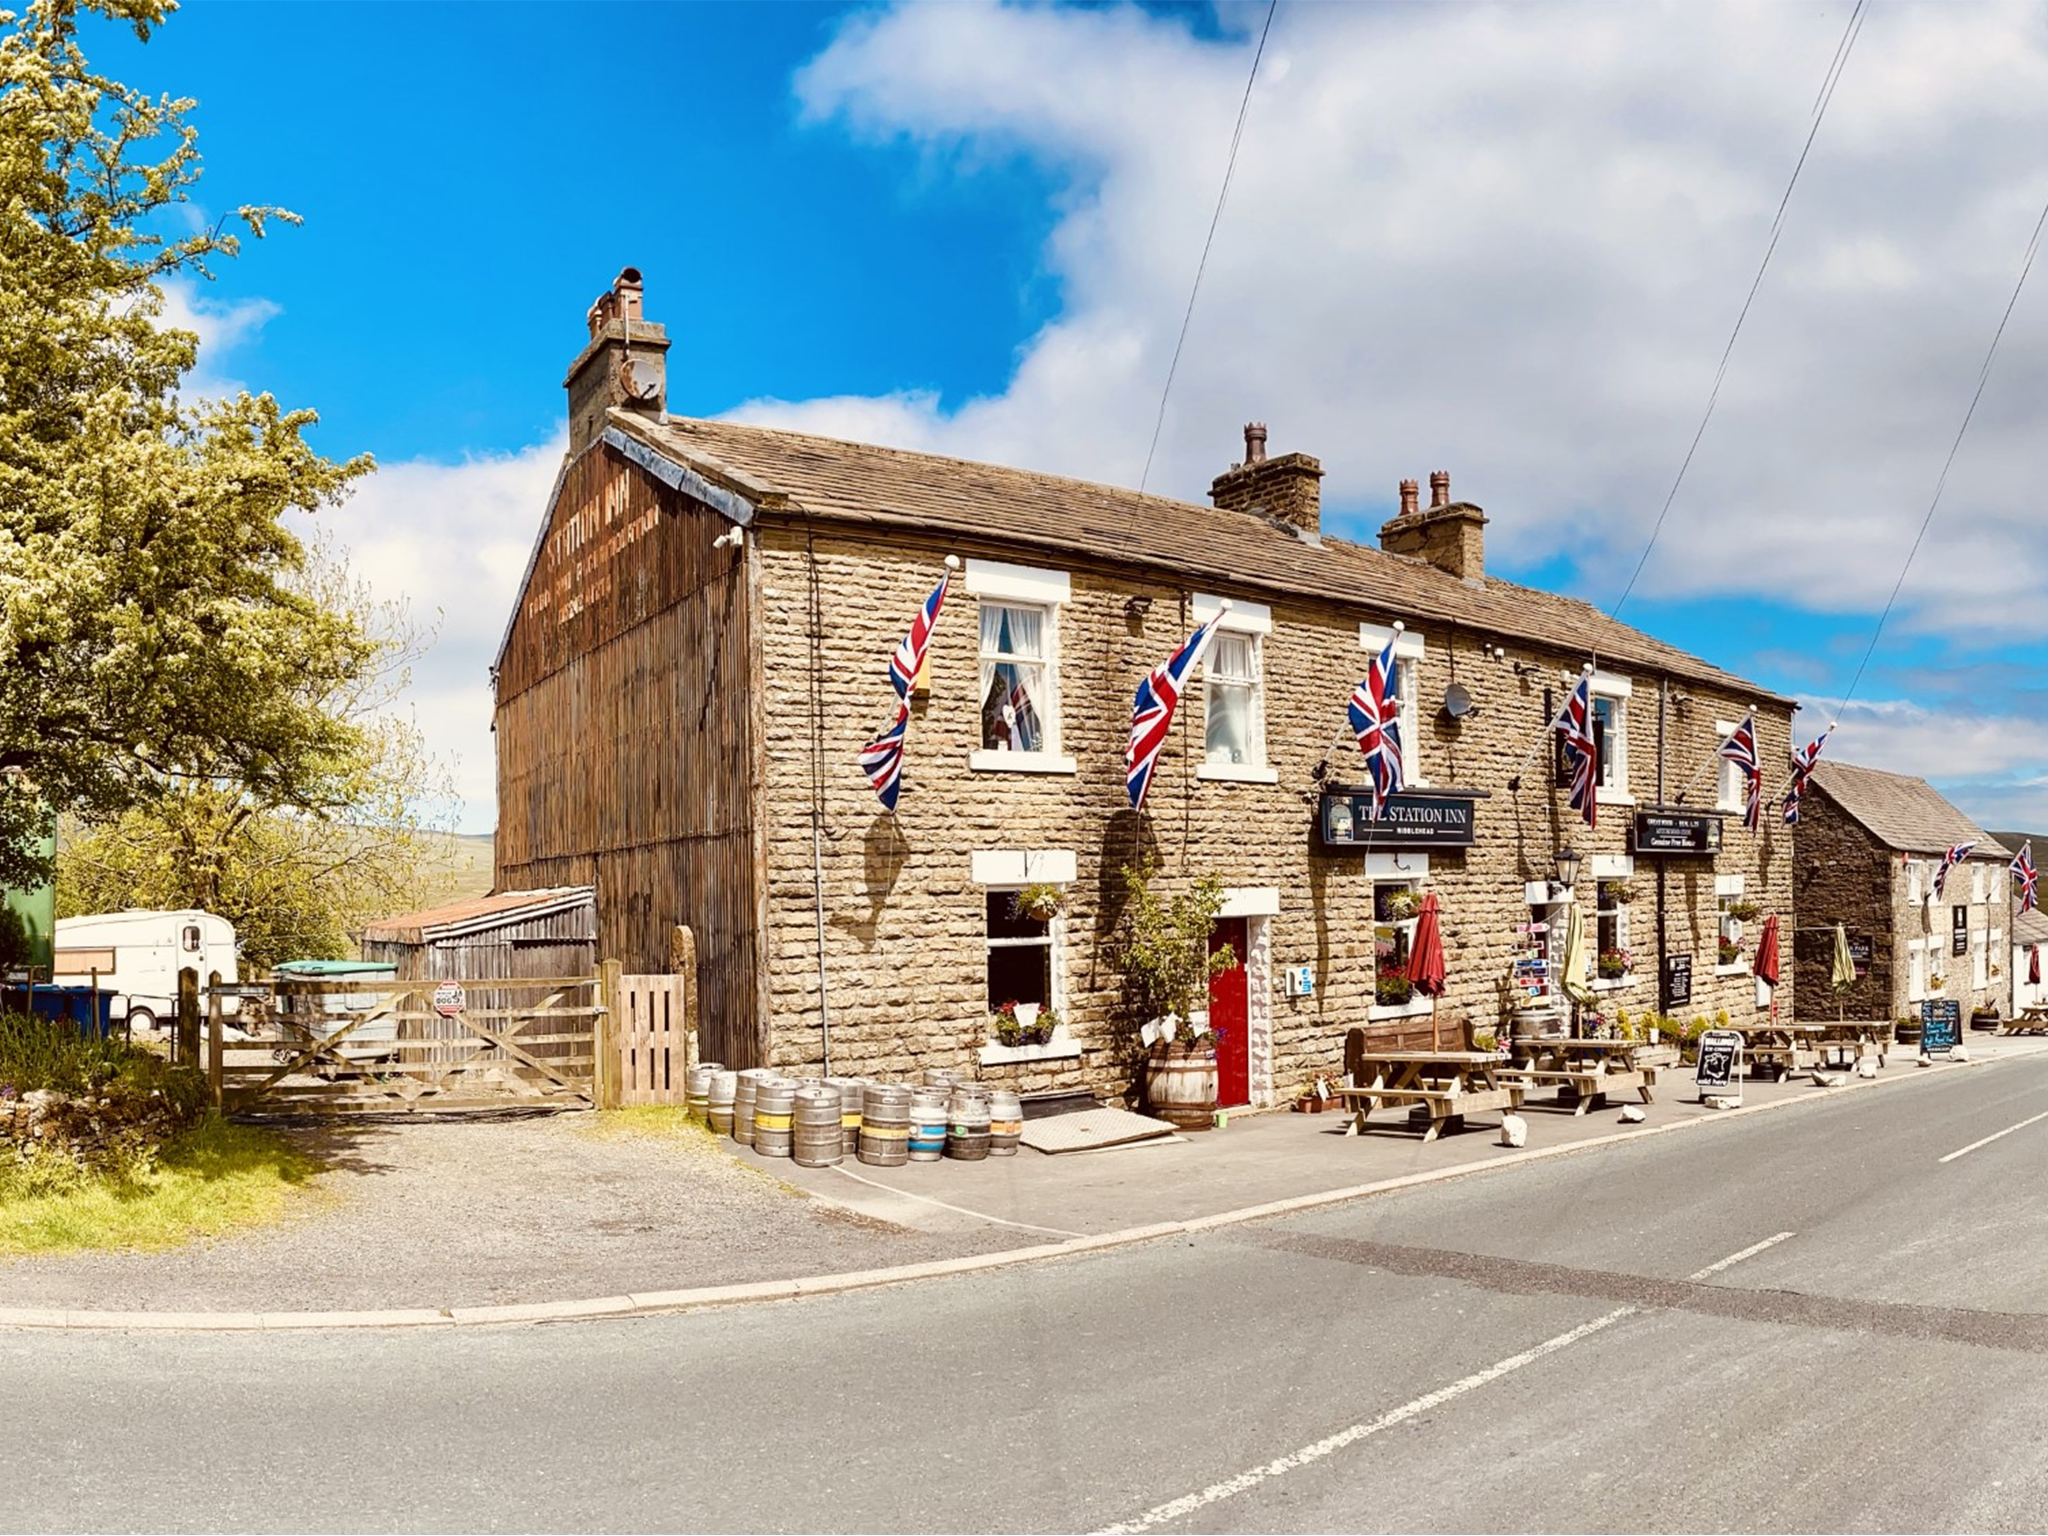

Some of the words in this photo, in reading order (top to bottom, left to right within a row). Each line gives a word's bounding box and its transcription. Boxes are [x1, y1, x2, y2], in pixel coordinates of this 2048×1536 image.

[547, 494, 600, 573] STATION
[1389, 805, 1442, 823] STATION
[1445, 808, 1466, 824] INN
